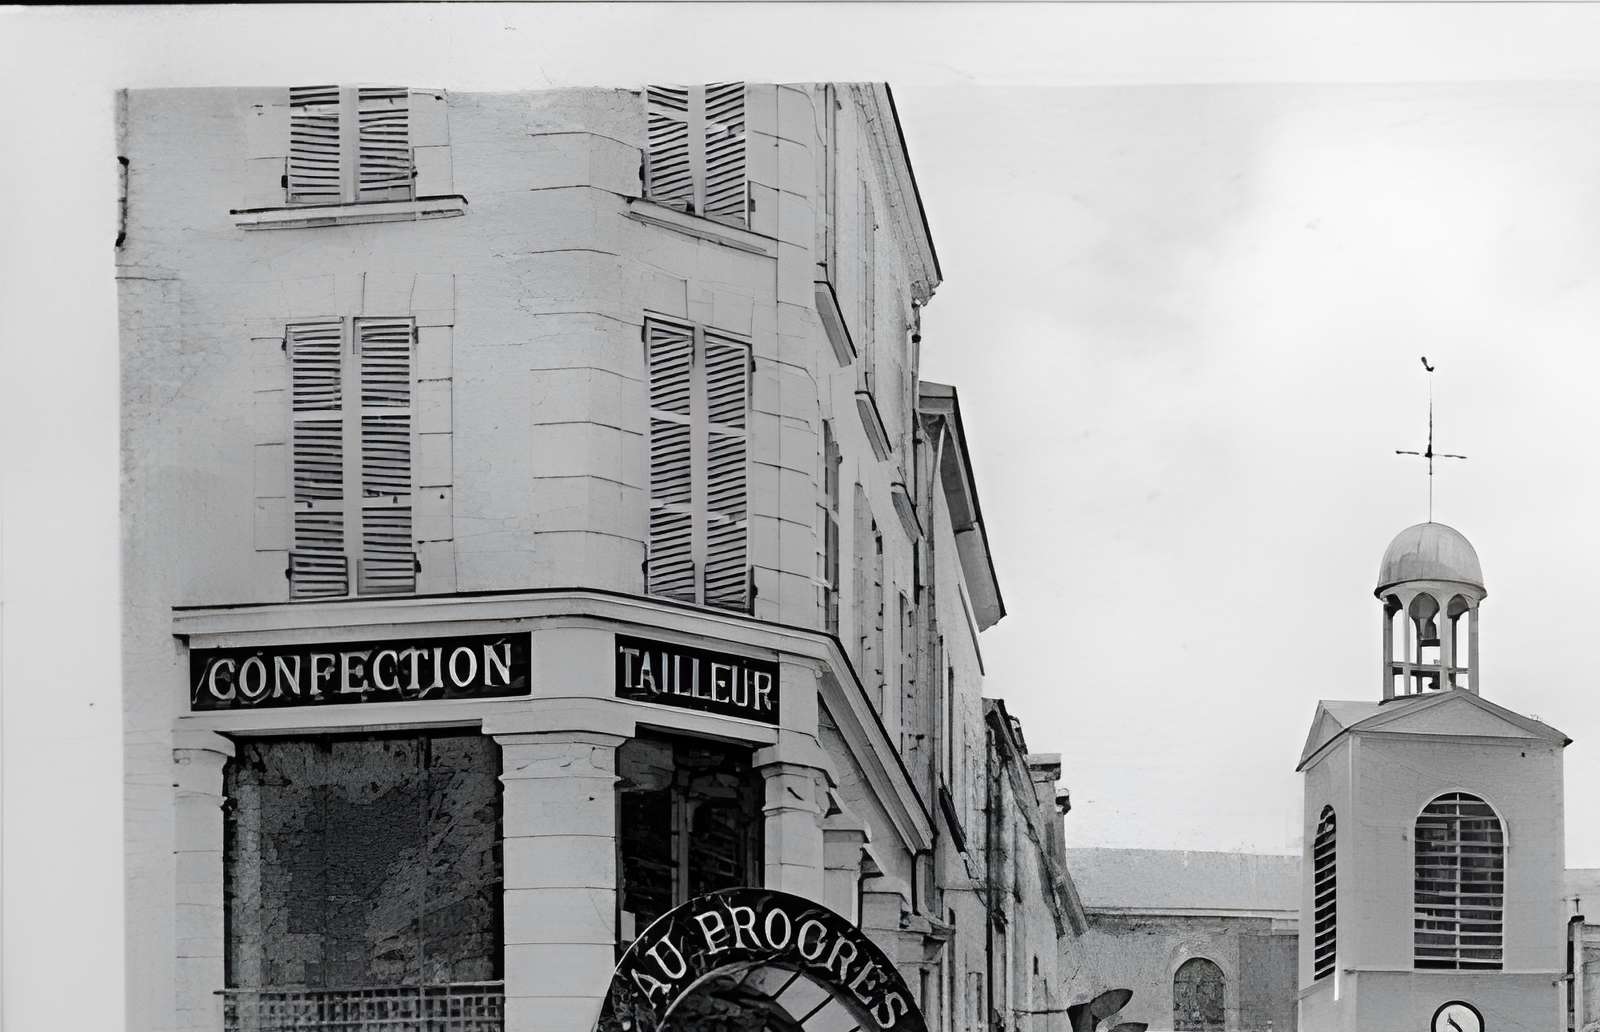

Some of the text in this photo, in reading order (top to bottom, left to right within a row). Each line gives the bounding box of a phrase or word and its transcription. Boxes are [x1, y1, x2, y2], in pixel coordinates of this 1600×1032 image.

[207, 642, 512, 701] CONFECTION
[619, 645, 773, 712] TAILLEUR
[631, 917, 688, 1010] AU
